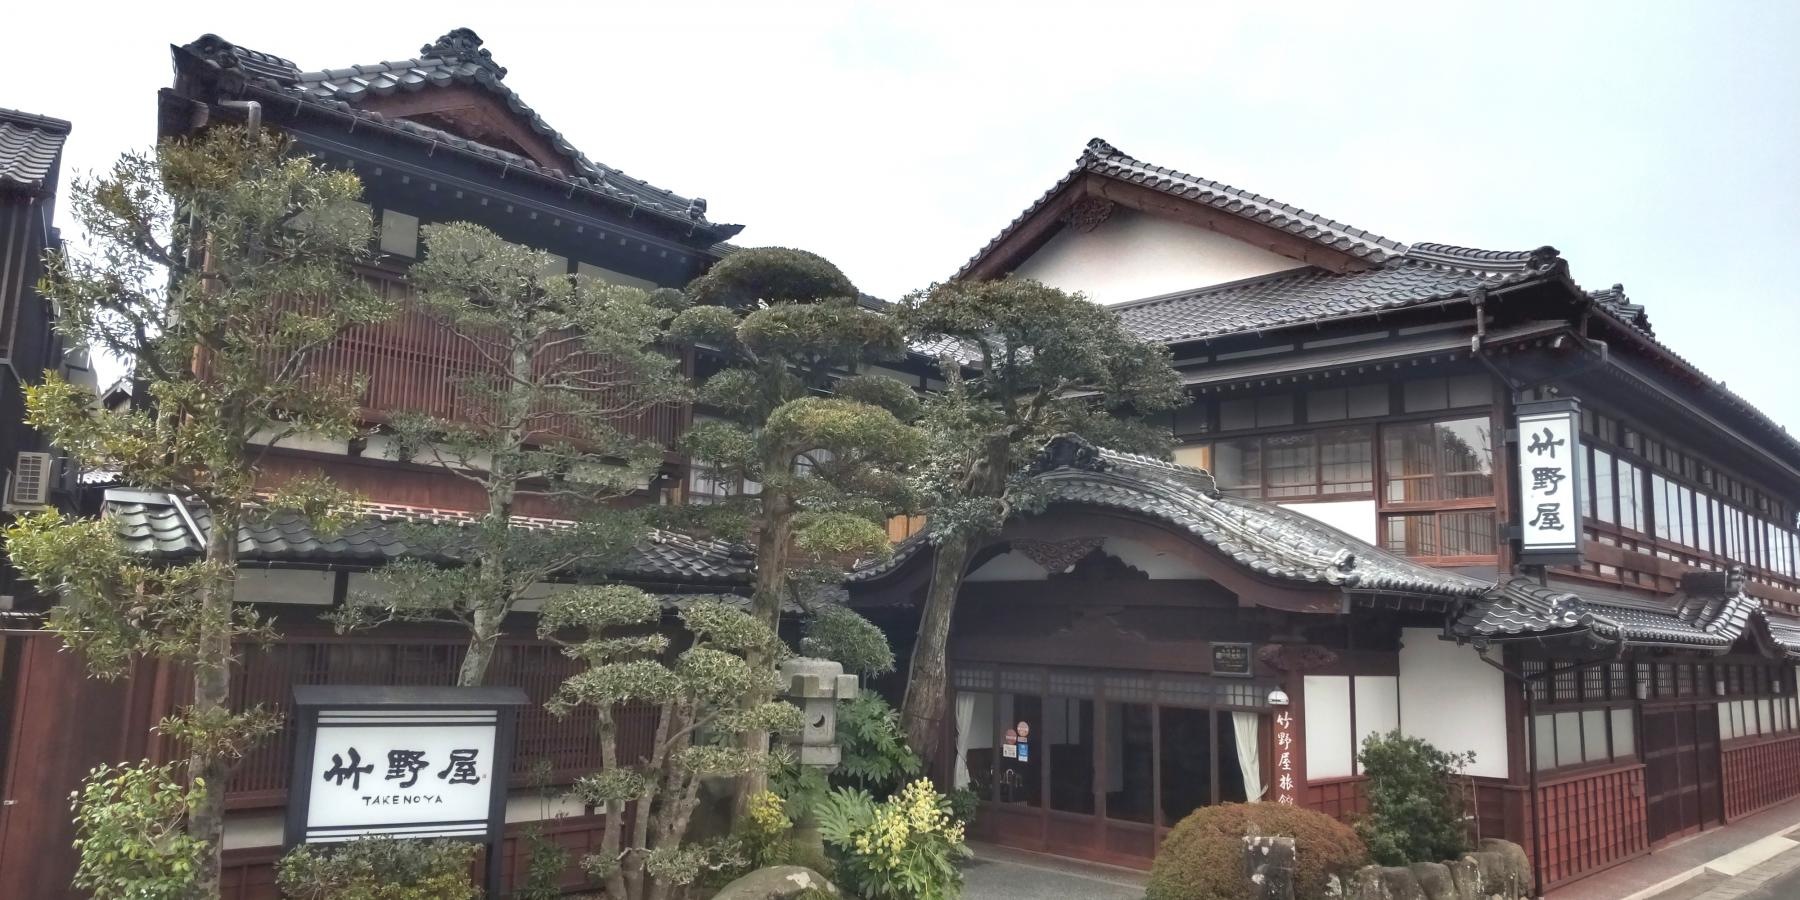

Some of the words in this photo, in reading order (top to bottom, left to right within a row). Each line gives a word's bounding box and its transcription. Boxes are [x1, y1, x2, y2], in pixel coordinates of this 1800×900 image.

[1527, 427, 1566, 531] 竹野屋
[323, 746, 480, 790] 竹野屋
[361, 795, 443, 806] TAKENOYA
